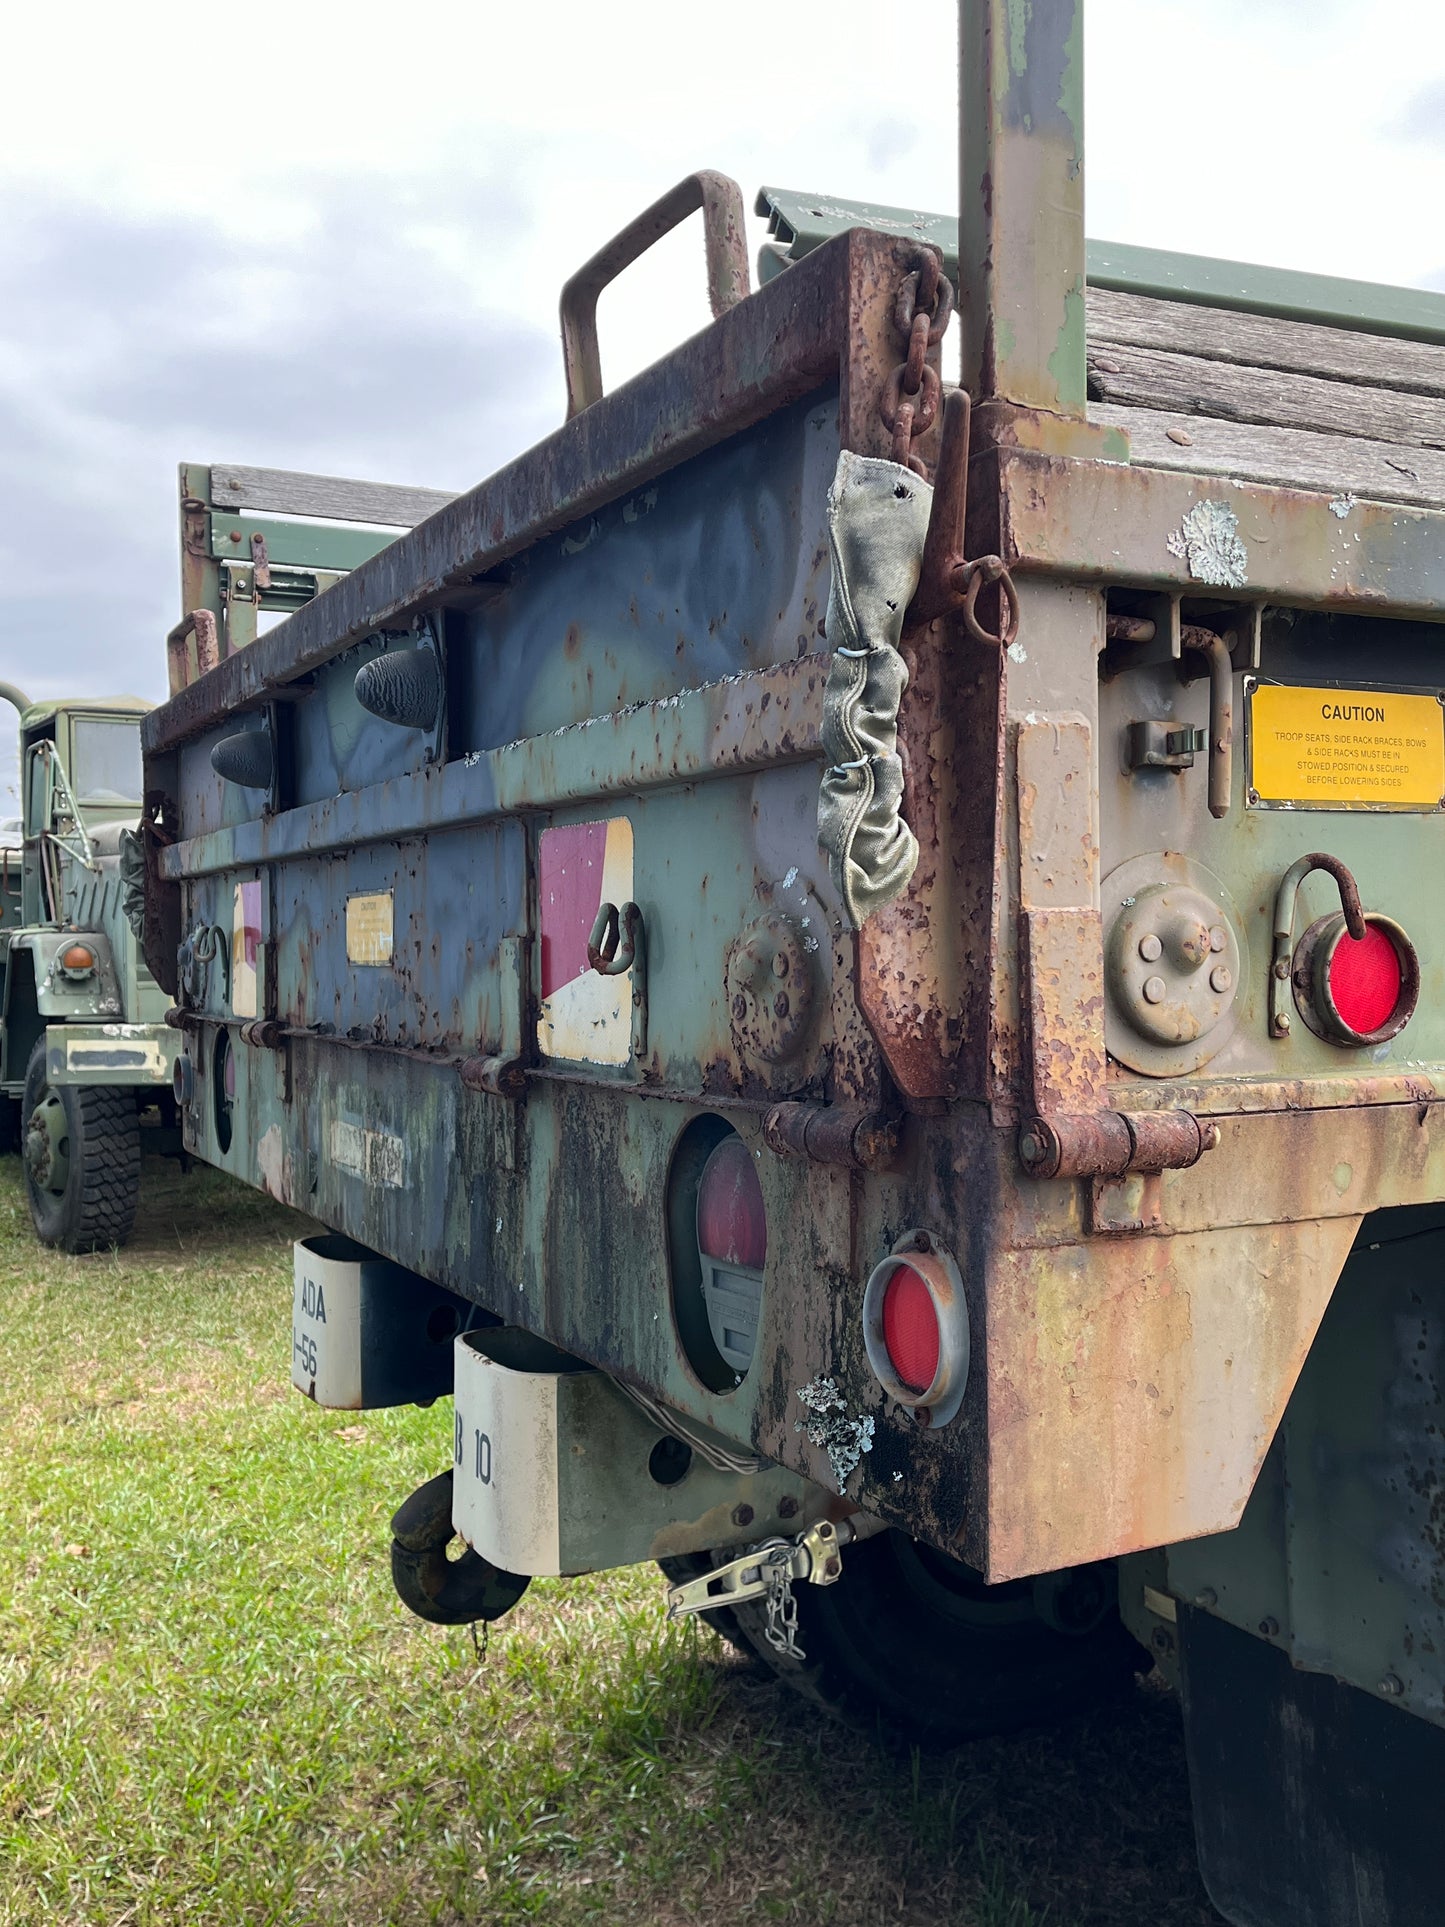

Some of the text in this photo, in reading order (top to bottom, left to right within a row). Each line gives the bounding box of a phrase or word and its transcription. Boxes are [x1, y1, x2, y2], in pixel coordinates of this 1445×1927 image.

[1321, 704, 1385, 722] CAUTION
[1275, 732, 1303, 741] TROOP
[1334, 735, 1351, 744] SIDE
[1352, 736, 1373, 745] RACK
[1405, 739, 1427, 748] BOWS
[1307, 748, 1401, 760] & SIDE RACKS MUST BE IN
[1297, 761, 1409, 774] STOWED POSITION & SECURED
[1307, 776, 1402, 787] BEFORE LOWERING SIDES
[301, 1276, 327, 1324] ADA
[475, 1429, 491, 1485] 10
